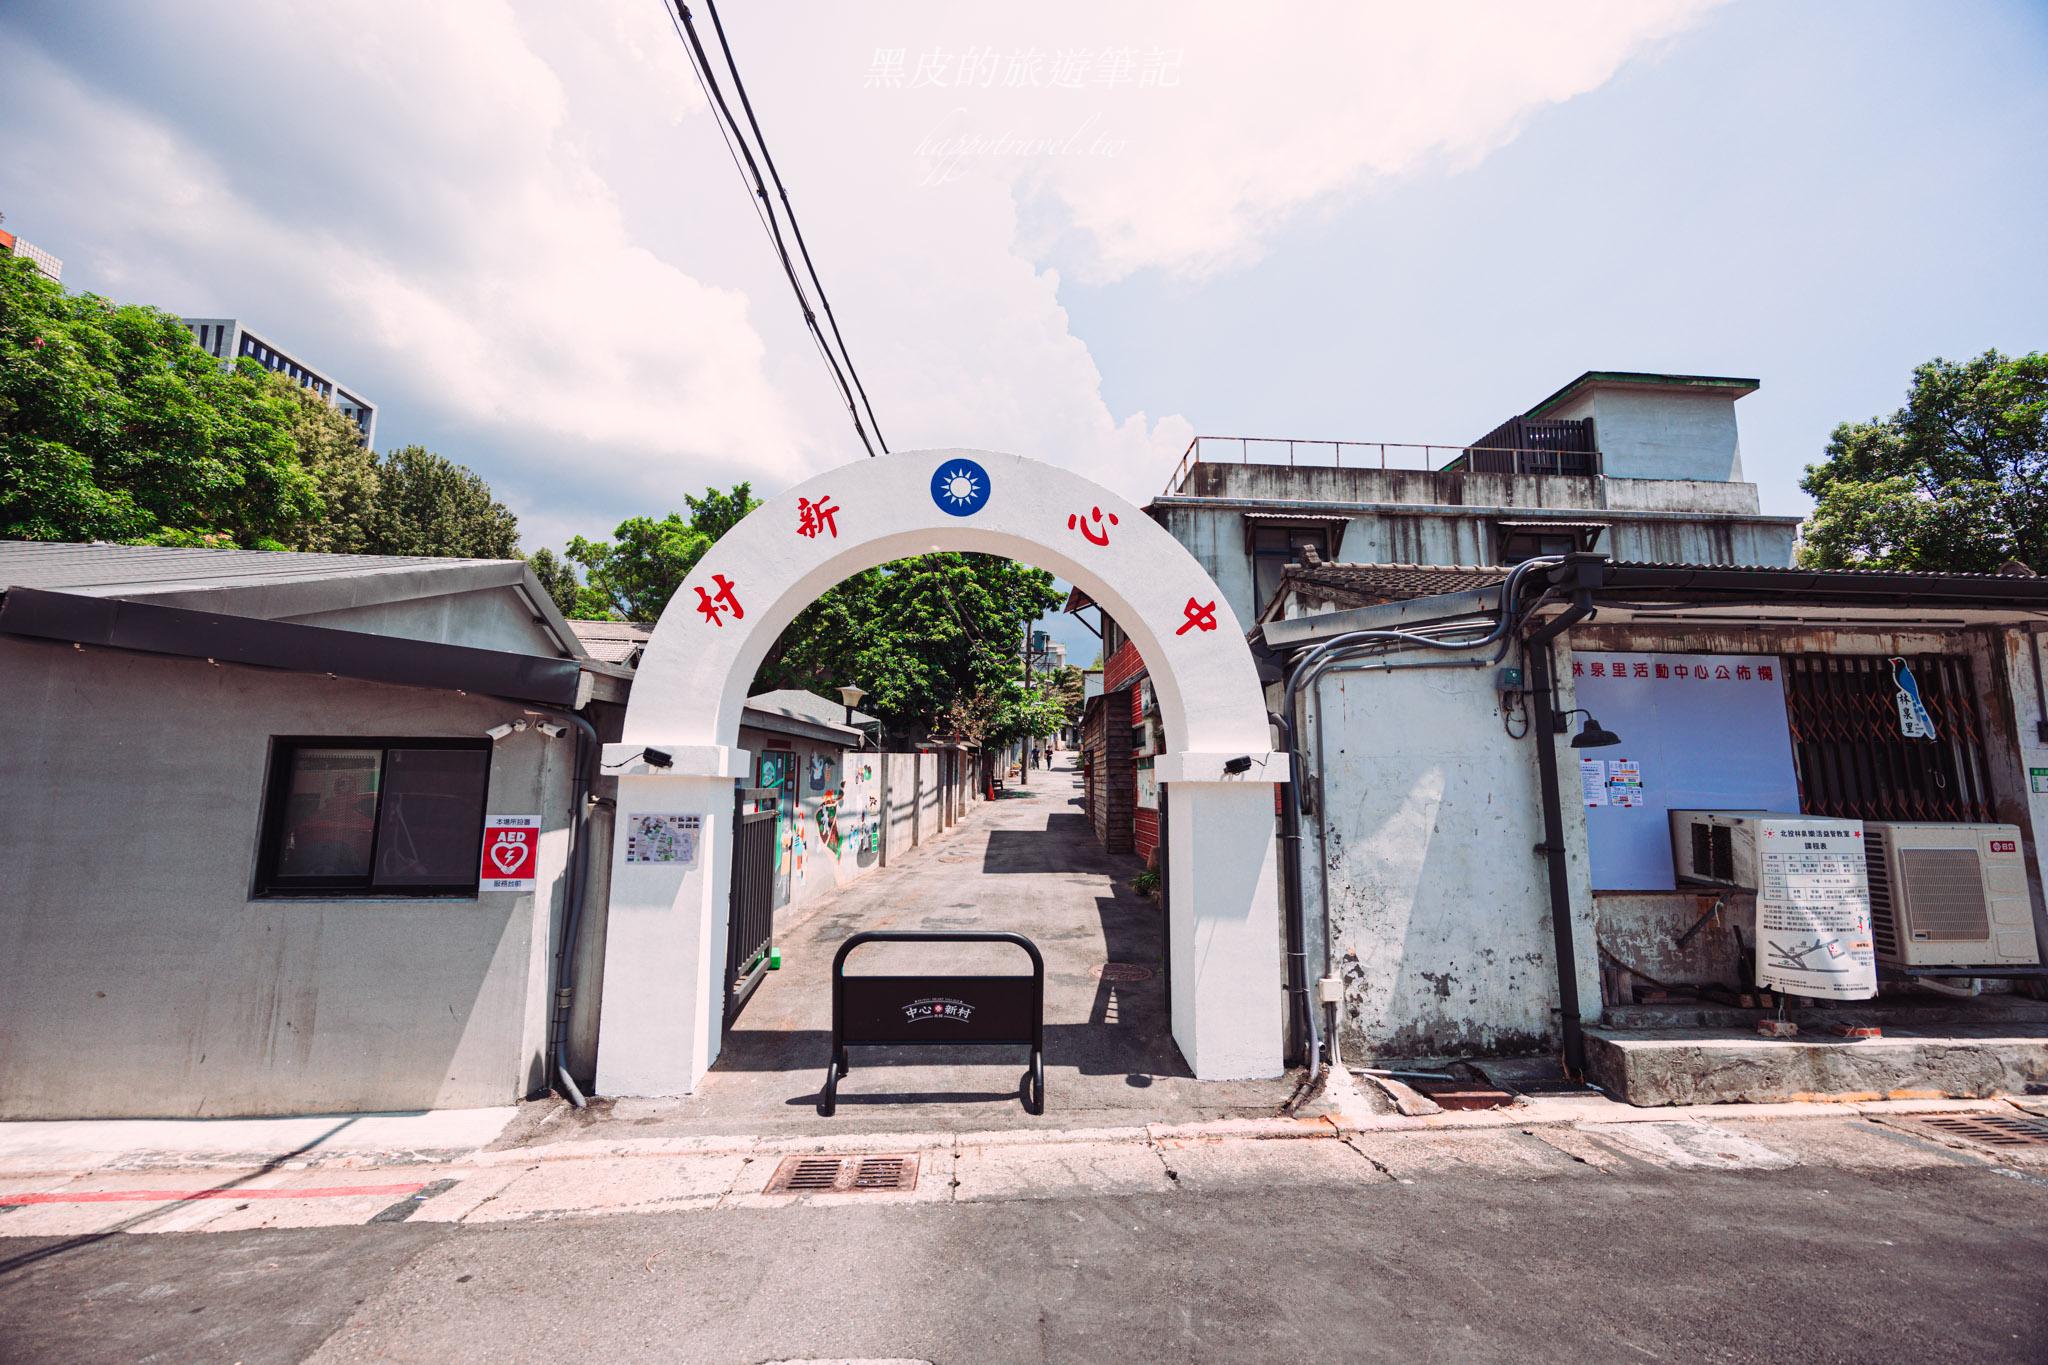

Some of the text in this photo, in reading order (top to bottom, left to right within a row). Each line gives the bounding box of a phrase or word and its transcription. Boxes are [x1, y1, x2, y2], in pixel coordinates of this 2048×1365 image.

[1897, 694, 1914, 733] 林泉里
[497, 831, 526, 842] AED
